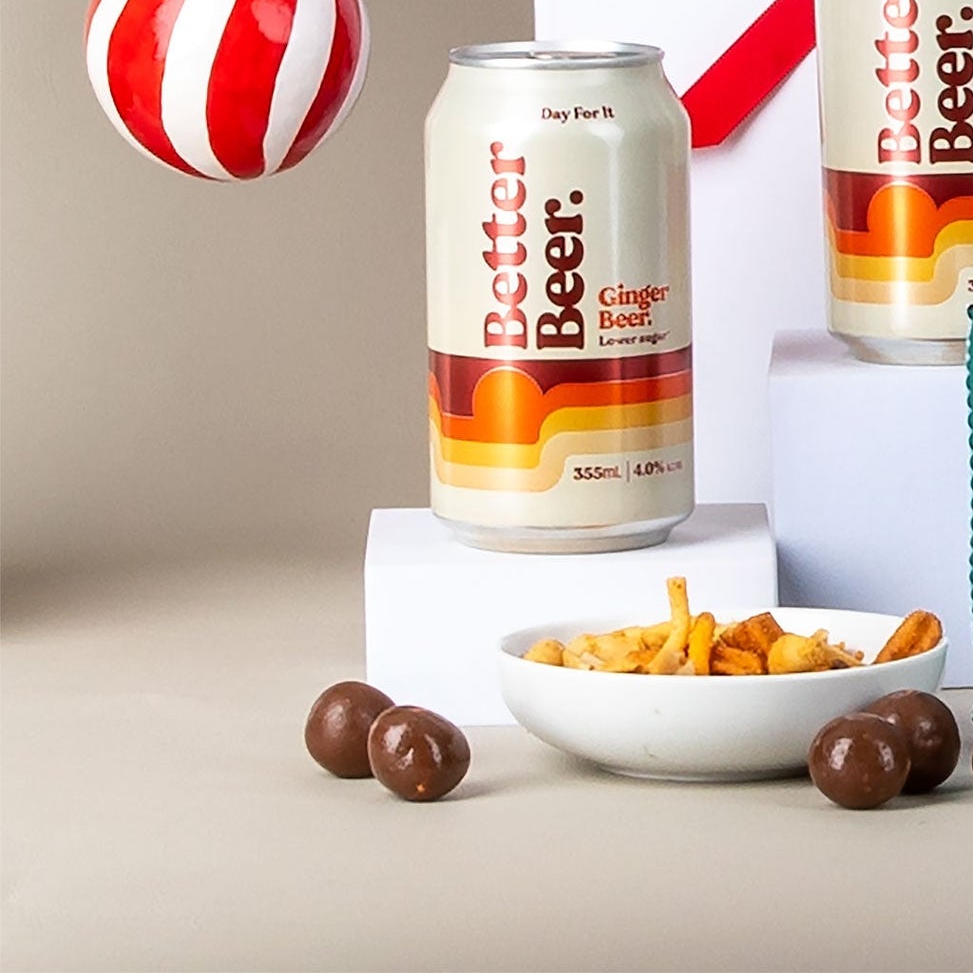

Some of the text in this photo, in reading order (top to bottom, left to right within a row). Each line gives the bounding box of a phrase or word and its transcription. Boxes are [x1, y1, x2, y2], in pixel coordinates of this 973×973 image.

[542, 106, 615, 123] Day For It
[483, 141, 528, 350] Better
[536, 190, 584, 351] Beer.
[598, 283, 670, 310] Ginger
[599, 311, 652, 329] Beer.
[573, 466, 622, 480] 355mL
[633, 461, 664, 477] 4.0%
